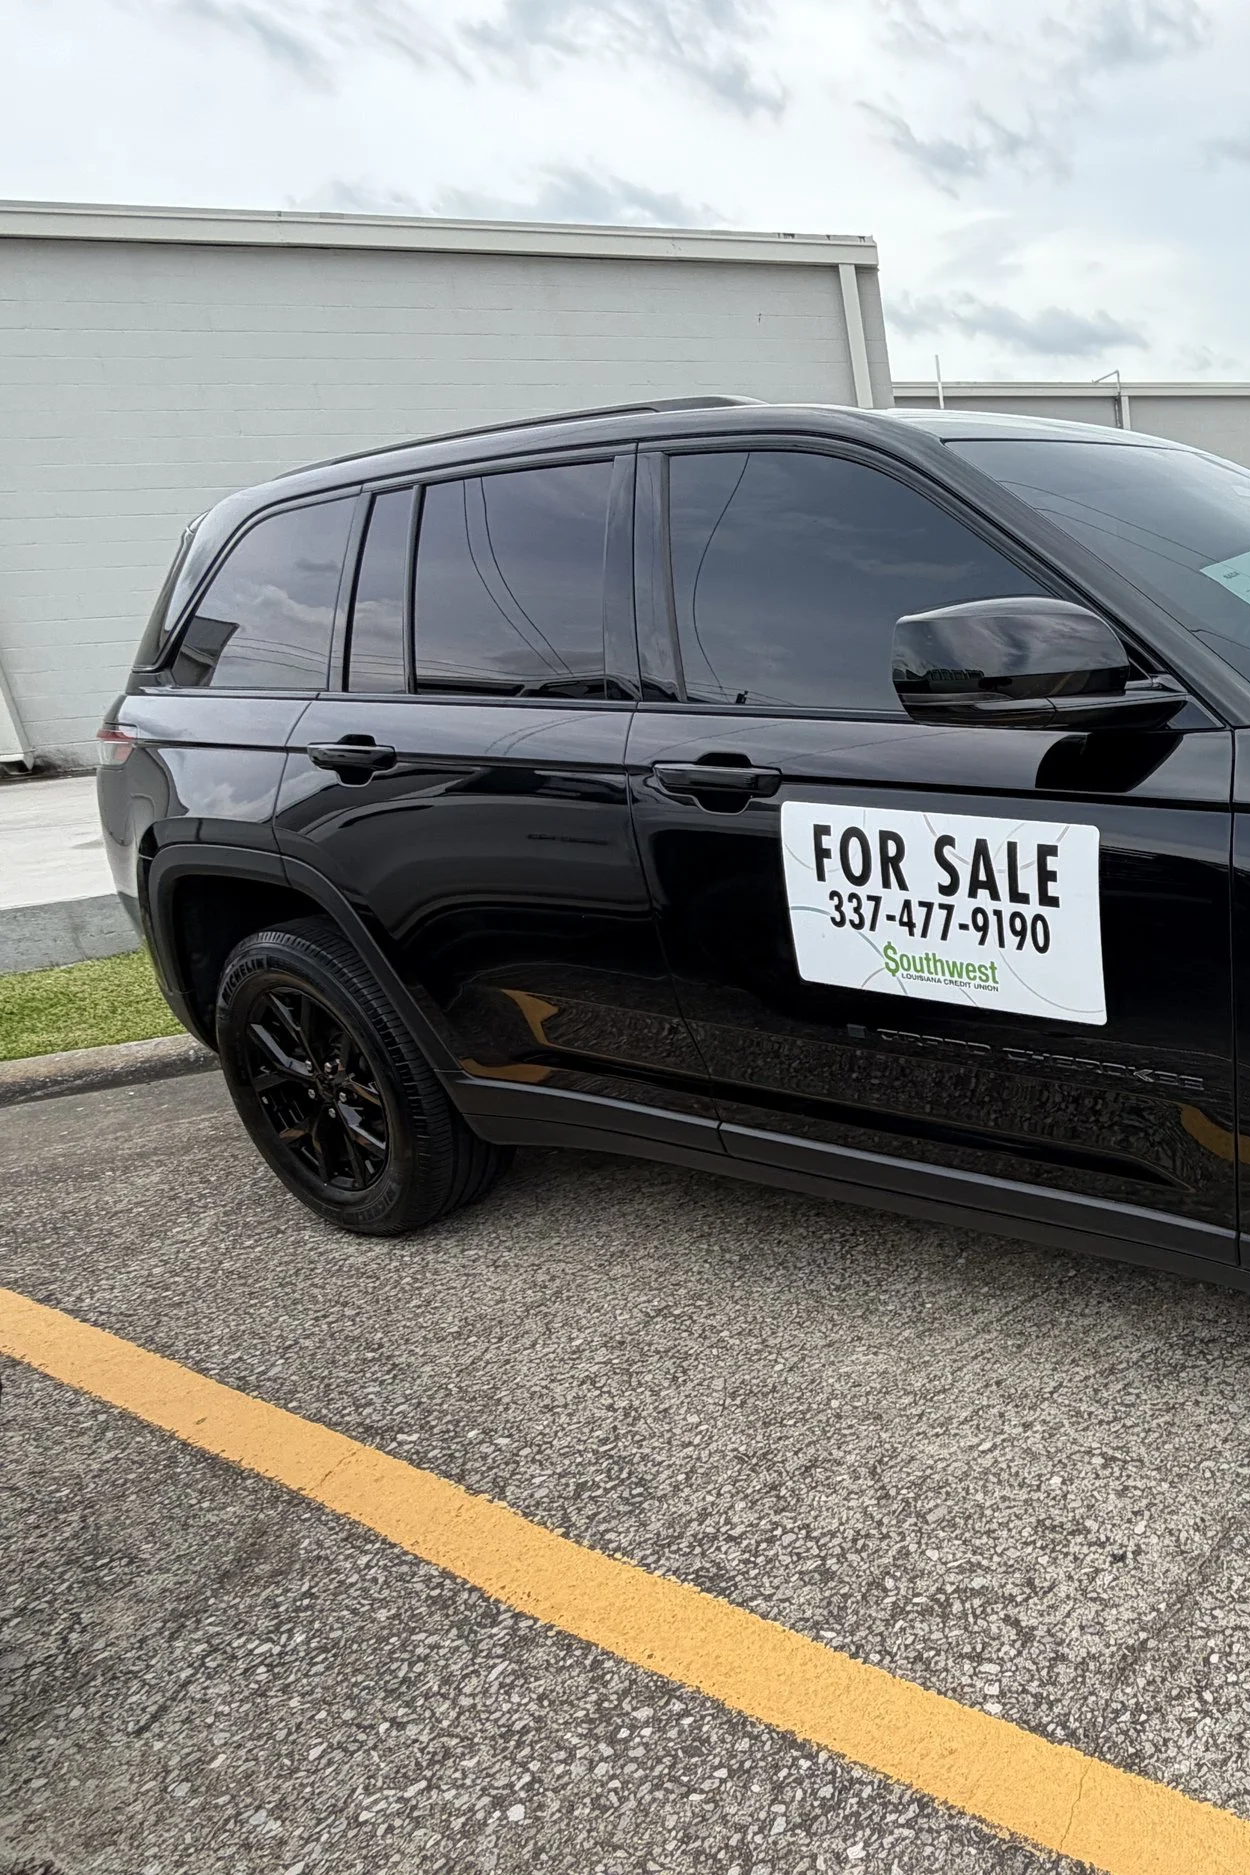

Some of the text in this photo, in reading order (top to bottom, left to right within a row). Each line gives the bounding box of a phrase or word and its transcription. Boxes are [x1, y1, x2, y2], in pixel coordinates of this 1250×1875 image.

[812, 823, 1060, 908] FOR SALE
[828, 890, 1051, 954] 337-477-9190
[901, 973, 999, 992] LOUISIANA CREDIT UNION
